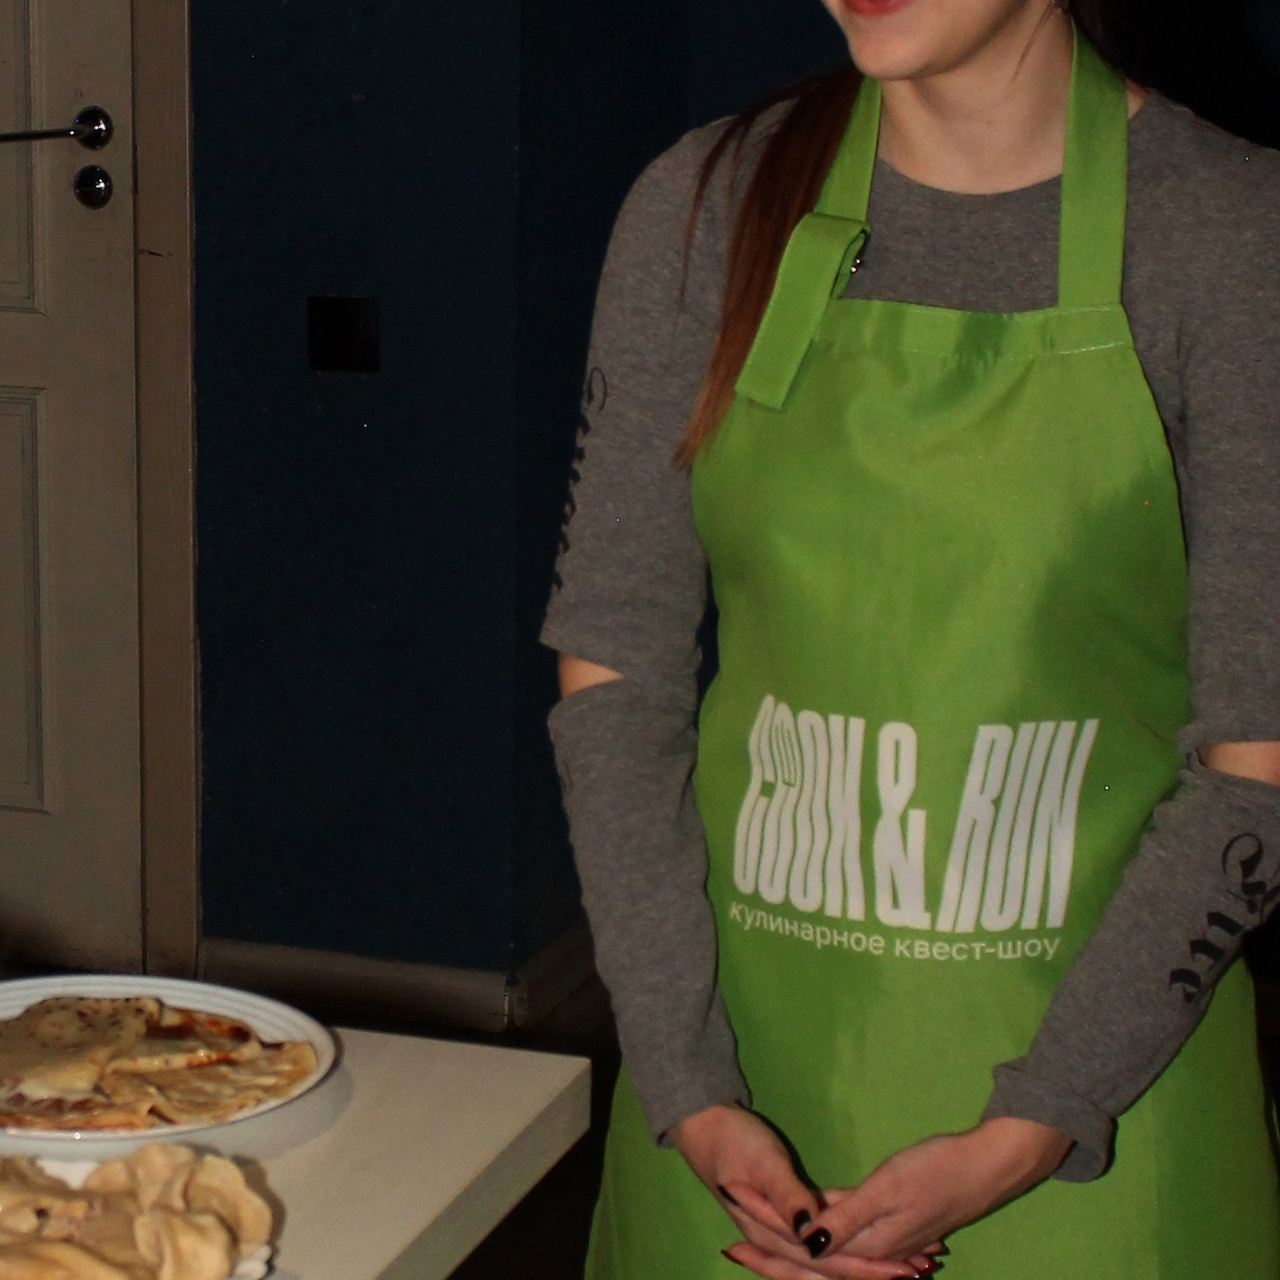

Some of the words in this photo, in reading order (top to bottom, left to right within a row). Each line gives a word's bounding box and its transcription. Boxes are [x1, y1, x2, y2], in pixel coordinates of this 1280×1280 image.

[873, 721, 932, 930] &
[935, 719, 1099, 933] RUN
[894, 937, 1061, 960] квест-шоу
